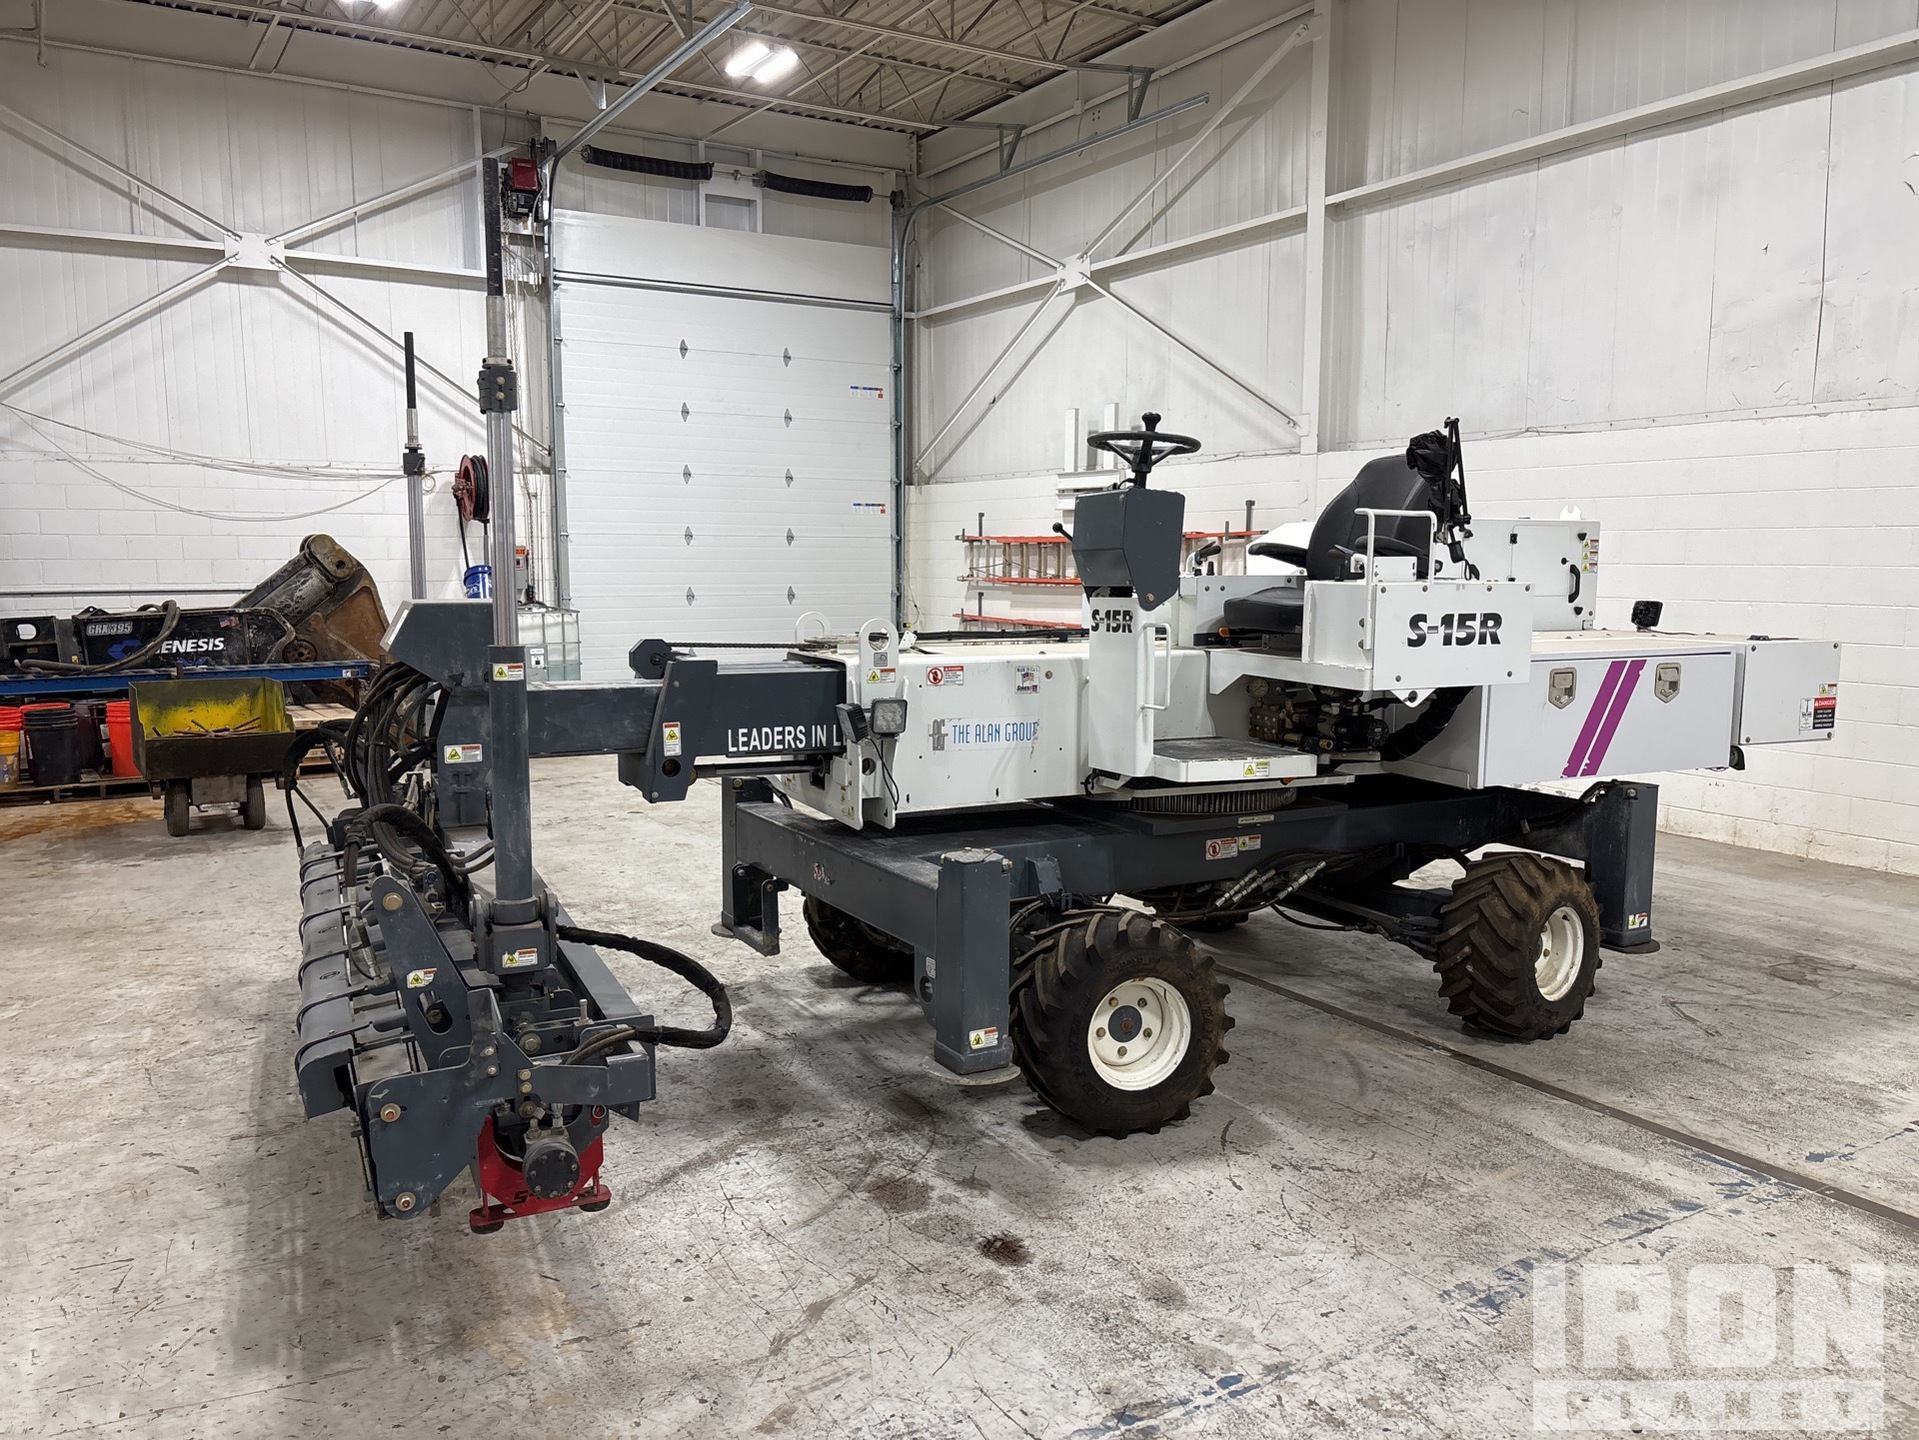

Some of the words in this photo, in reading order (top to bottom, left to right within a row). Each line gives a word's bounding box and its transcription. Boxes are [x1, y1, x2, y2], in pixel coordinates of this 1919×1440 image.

[1090, 609, 1134, 633] S-15R
[1407, 613, 1503, 647] S-15R
[728, 725, 806, 752] LEADERS
[811, 724, 827, 747] IN
[952, 724, 970, 744] THE
[975, 723, 1001, 743] ALAN
